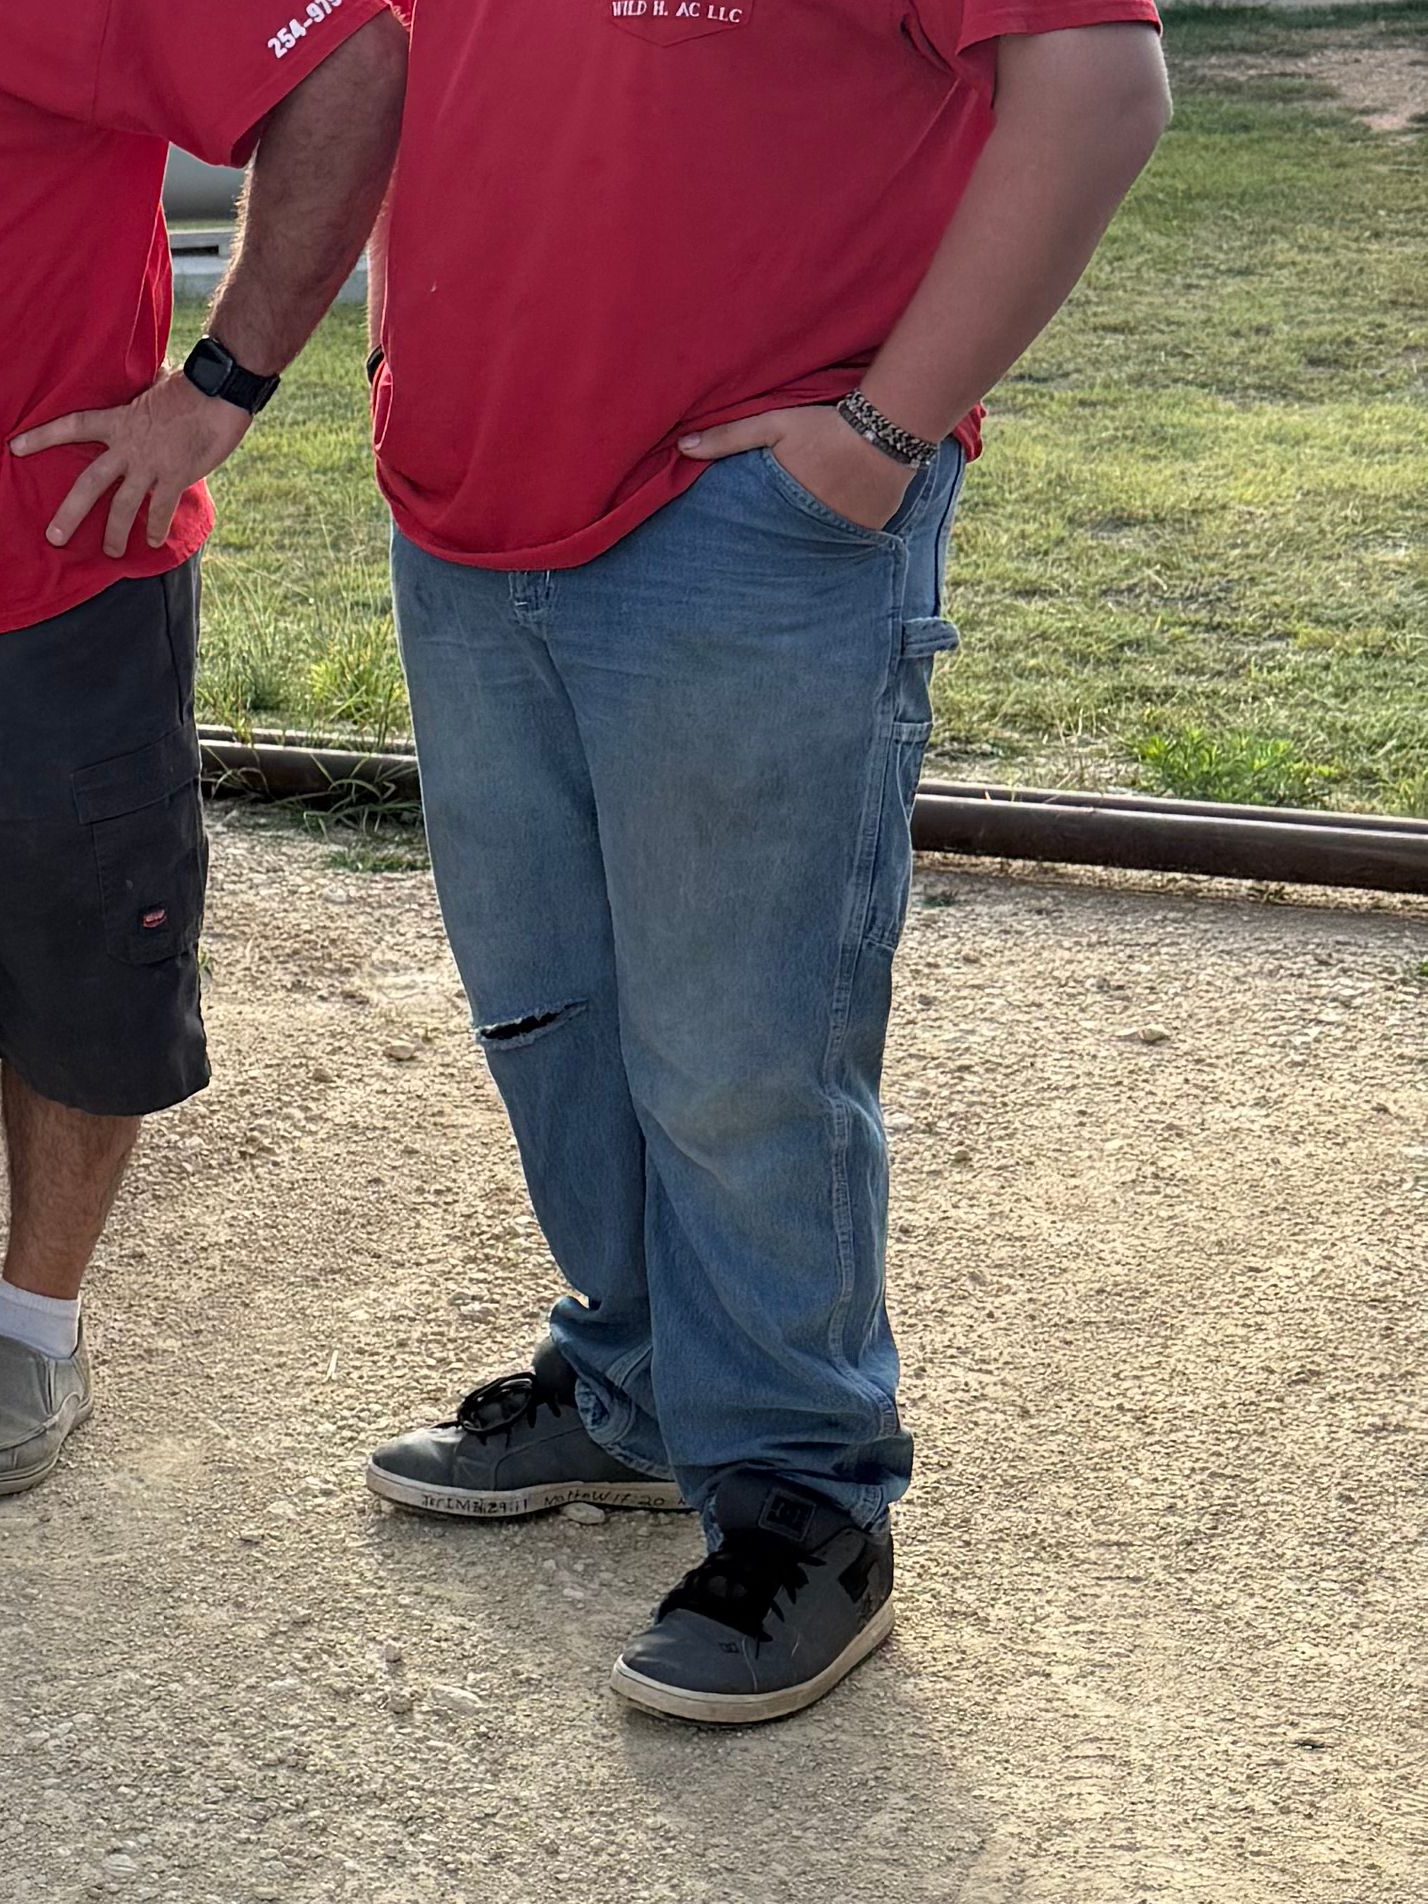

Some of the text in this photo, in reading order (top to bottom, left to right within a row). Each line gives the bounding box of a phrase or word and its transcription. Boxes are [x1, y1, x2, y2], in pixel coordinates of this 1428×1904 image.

[612, 0, 743, 24] WILD H. AC LLC
